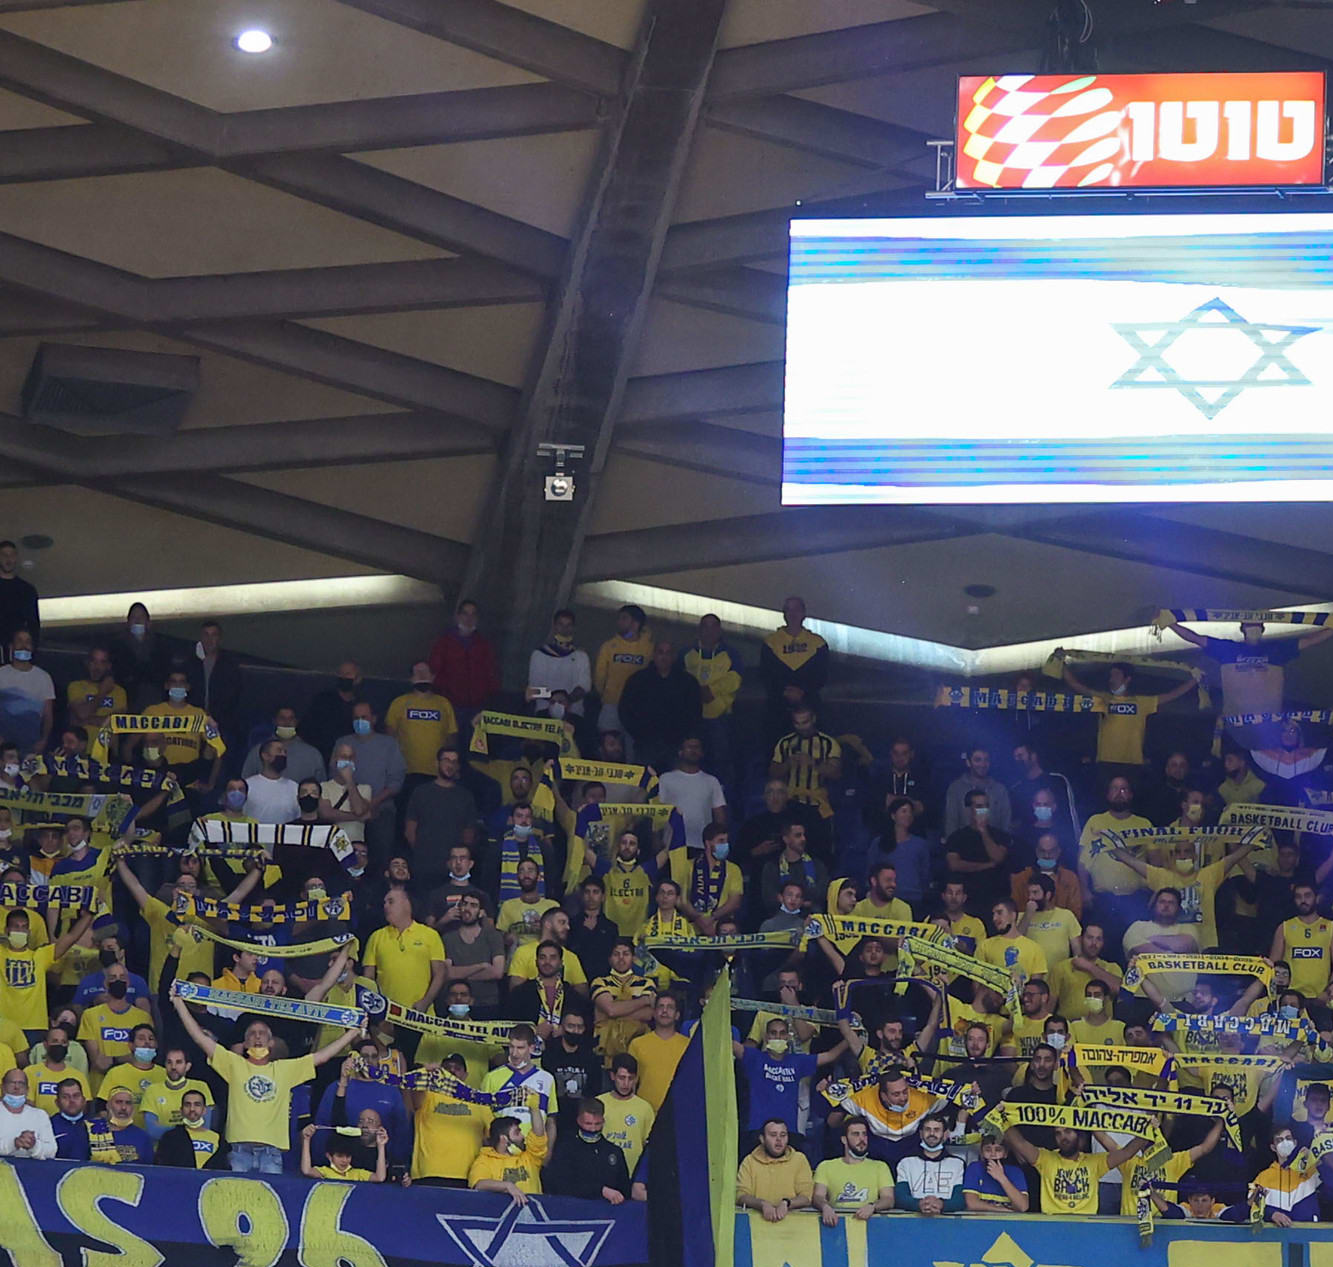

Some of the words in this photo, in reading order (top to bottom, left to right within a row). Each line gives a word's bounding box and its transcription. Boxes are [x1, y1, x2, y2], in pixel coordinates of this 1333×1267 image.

[1130, 100, 1315, 161] טוטו
[116, 715, 189, 730] MACCABI
[409, 709, 440, 720] FOX
[1230, 812, 1302, 830] BASKETBALL
[841, 922, 928, 939] MACCABI
[1304, 929, 1312, 939] 6
[1293, 949, 1320, 958] FOX
[1147, 960, 1224, 972] BASKETBALL
[1233, 961, 1265, 976] CLUB
[1018, 1106, 1065, 1125] 100%
